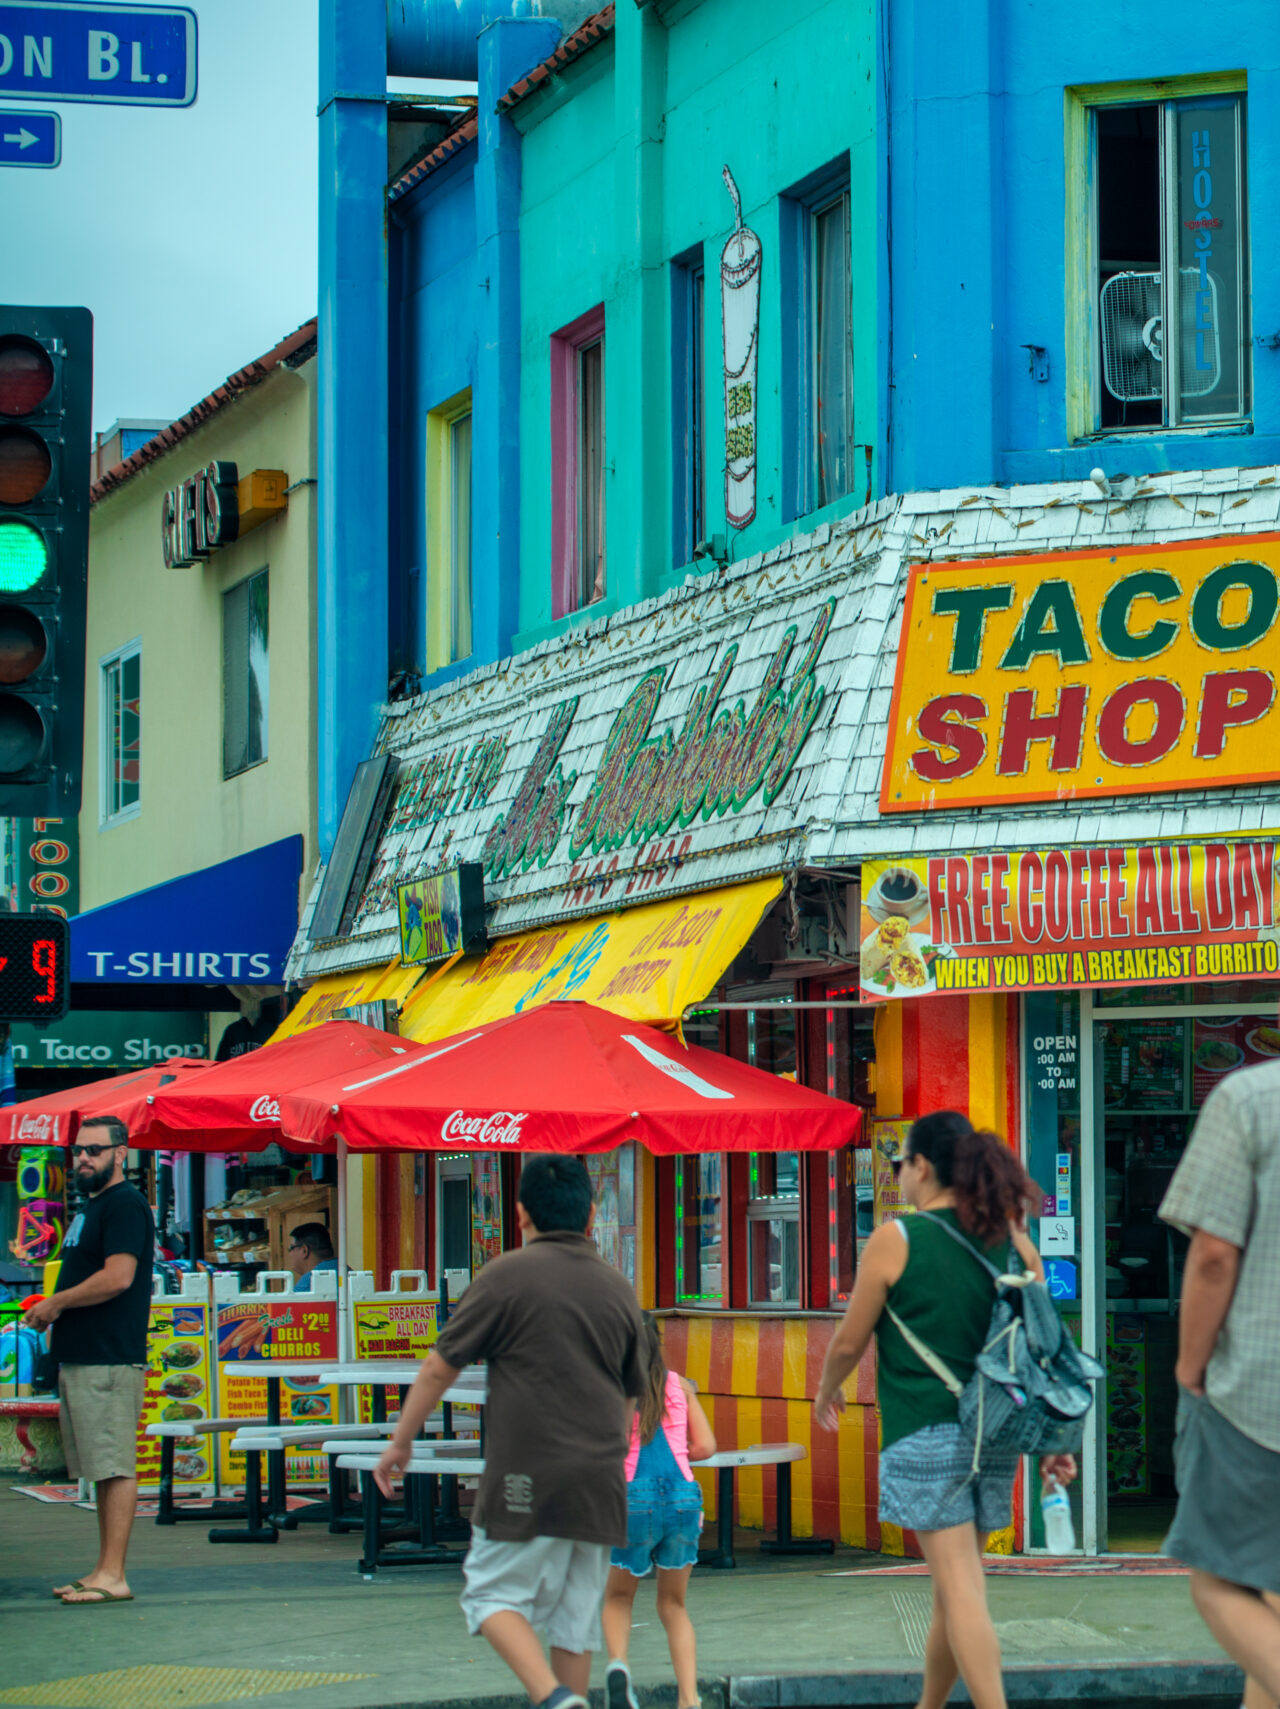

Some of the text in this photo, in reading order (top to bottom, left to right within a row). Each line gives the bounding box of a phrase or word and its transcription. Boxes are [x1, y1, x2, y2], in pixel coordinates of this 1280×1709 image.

[1192, 130, 1213, 371] HOSTEL
[908, 667, 1278, 783] SHOP
[562, 835, 693, 910] TACO SHOP
[422, 879, 440, 917] FISH
[928, 841, 1276, 947] FREE COFFE ALL DAY
[424, 918, 443, 957] TACO
[32, 939, 56, 1003] 9
[87, 951, 271, 977] T-SHIRTS
[935, 939, 1278, 991] WHEN YOU BUY A BREAKFAST BURRITO
[40, 1039, 112, 1060] Taco
[124, 1038, 205, 1063] Shop
[1033, 1035, 1077, 1051] OPEN
[1057, 1052, 1075, 1063] AM
[1046, 1067, 1062, 1077] TO
[1057, 1078, 1075, 1089] AM
[441, 1110, 529, 1145] Coca-Cola
[258, 1307, 294, 1334] Fresh
[388, 1305, 435, 1321] BREAKFAST
[277, 1327, 304, 1341] DELI
[397, 1323, 411, 1337] ALL
[413, 1322, 429, 1336] DAY
[261, 1342, 321, 1357] CHURROS
[385, 1339, 411, 1351] BACON
[227, 1378, 251, 1387] Potato
[228, 1390, 242, 1398] Fish
[245, 1389, 261, 1398] Taco
[228, 1401, 252, 1410] Combo
